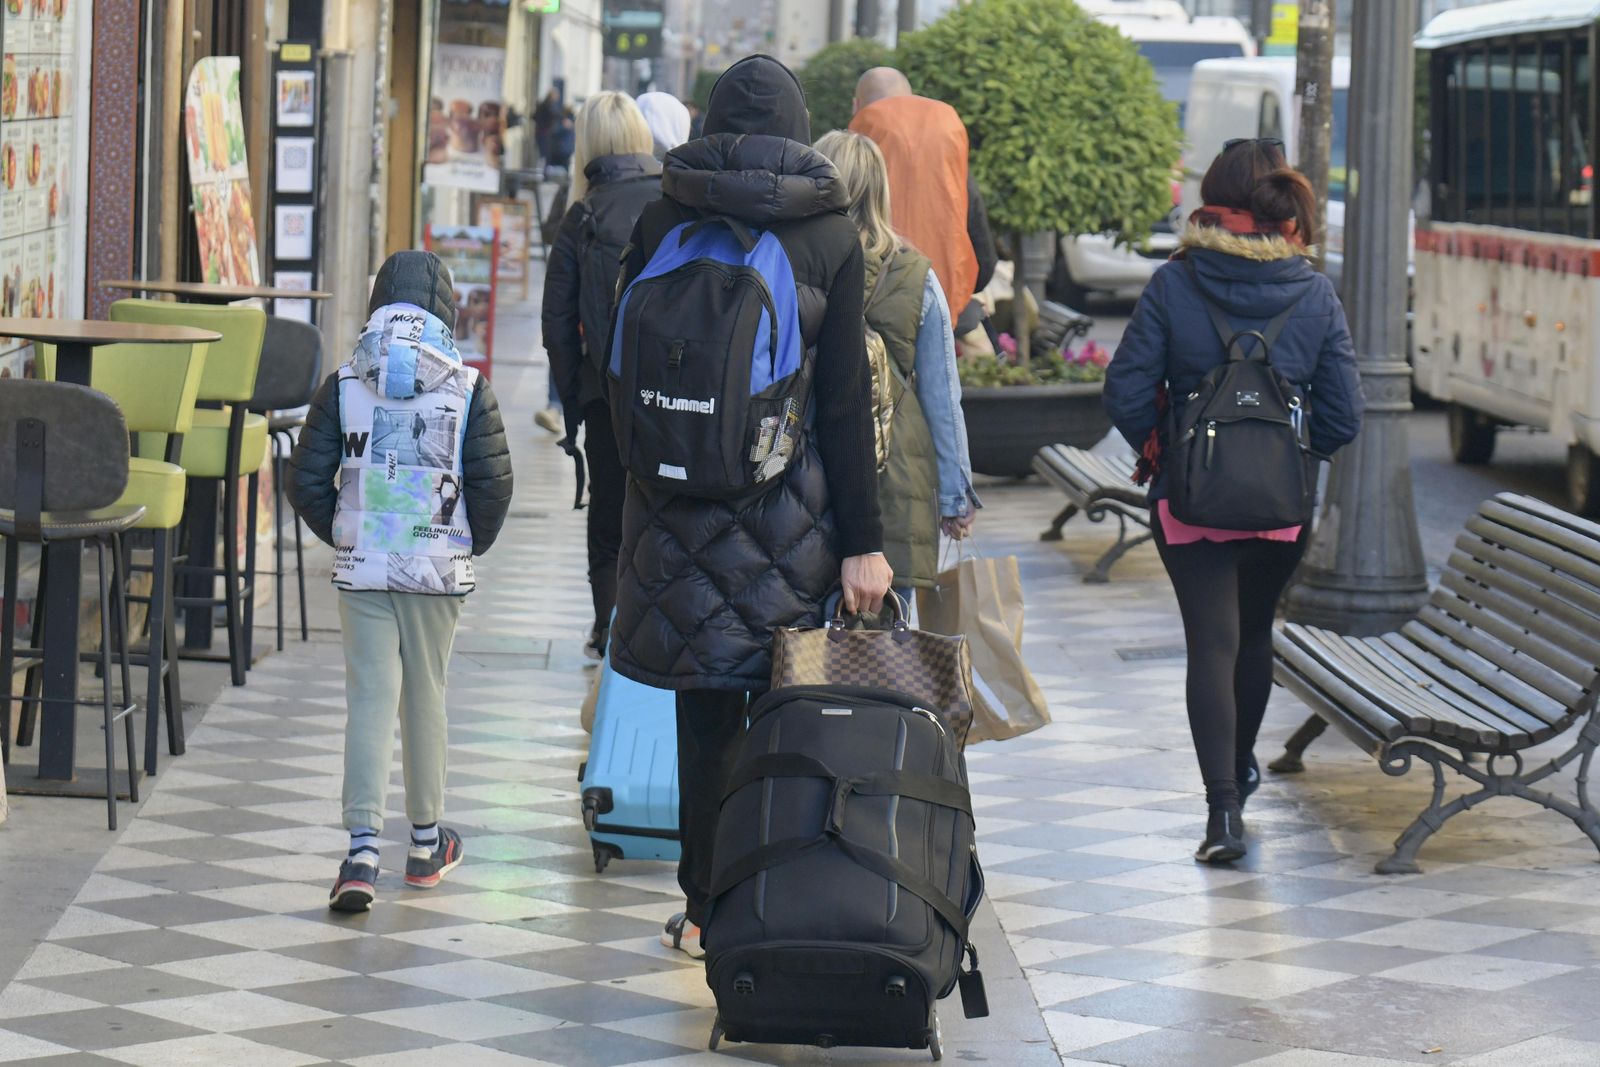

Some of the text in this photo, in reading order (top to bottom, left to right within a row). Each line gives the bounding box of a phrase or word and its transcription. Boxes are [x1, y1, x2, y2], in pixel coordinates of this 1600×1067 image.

[656, 390, 715, 414] hummel
[387, 453, 397, 480] YEAH!
[412, 531, 439, 539] GOOD
[413, 525, 449, 535] FEELING
